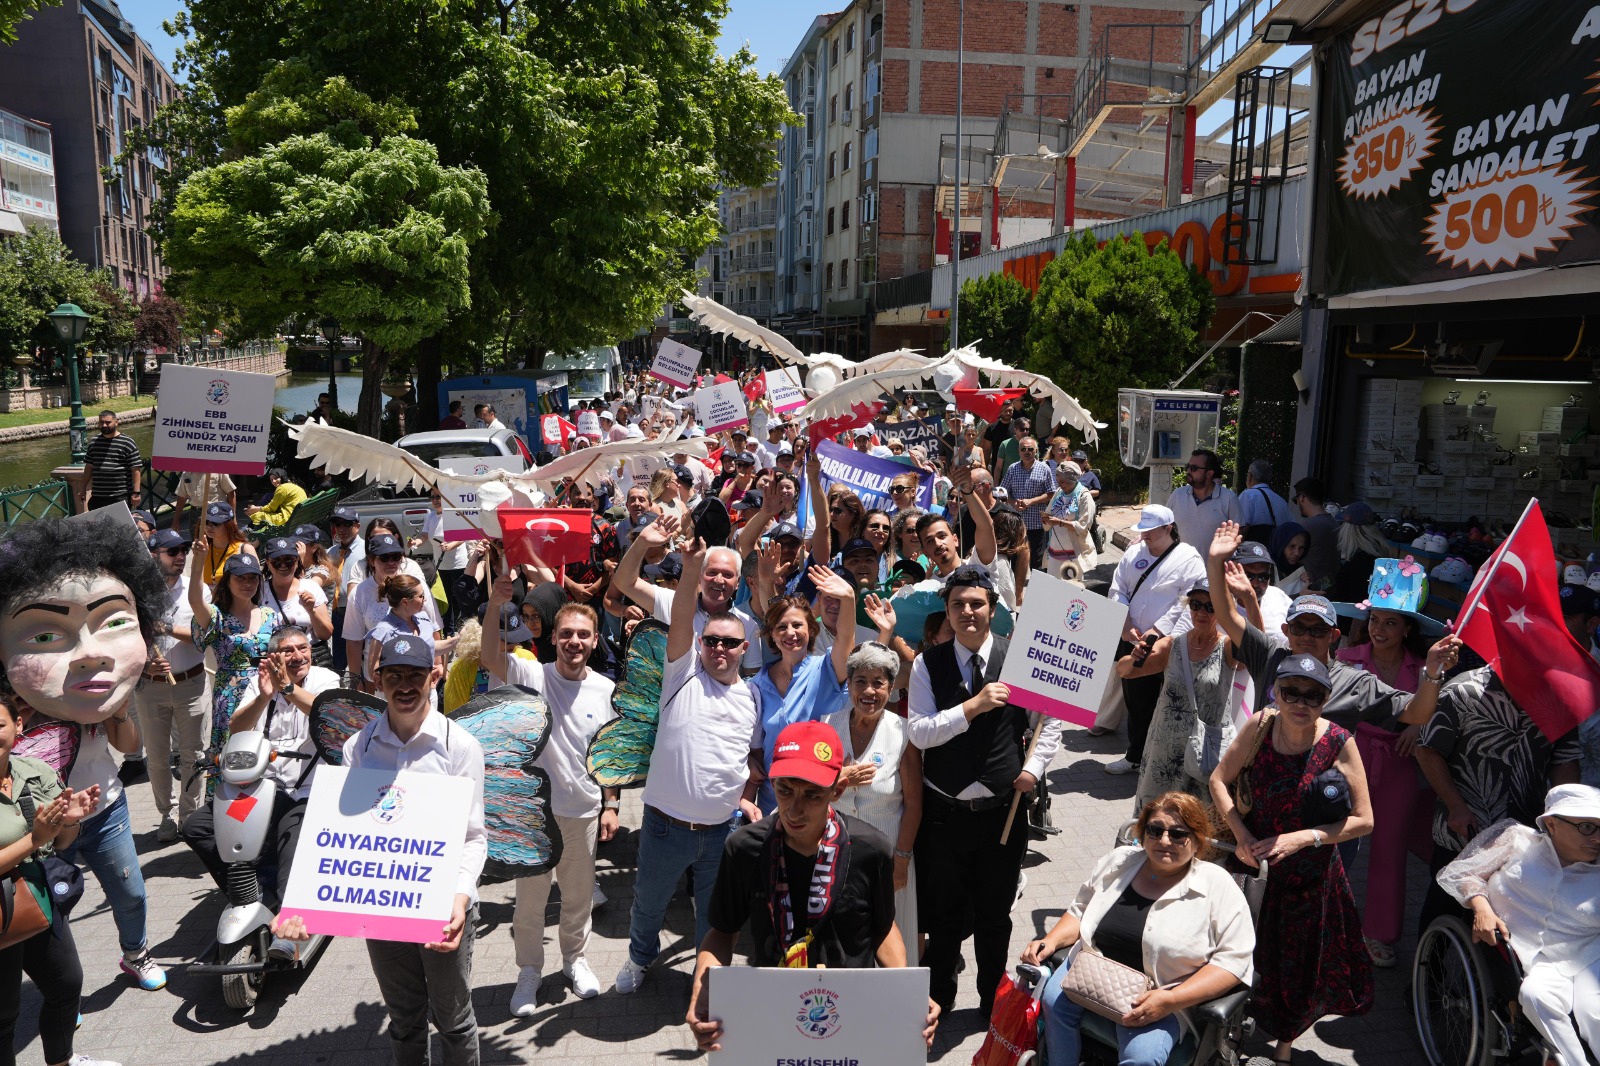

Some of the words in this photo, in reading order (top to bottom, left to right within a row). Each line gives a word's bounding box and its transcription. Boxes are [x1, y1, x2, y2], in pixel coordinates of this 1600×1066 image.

[1354, 49, 1426, 106] BAYAN
[1343, 73, 1442, 141] AYAKKABI
[1452, 93, 1570, 157] BAYAN
[1428, 124, 1600, 198] SANDALET
[204, 410, 227, 419] EBB
[1162, 402, 1210, 410] TELEFON
[162, 417, 215, 430] ZİHİNSEL
[218, 422, 264, 433] ENGELLİ
[168, 430, 217, 441] GÜNDÜZ
[220, 434, 257, 444] YAŞAM
[186, 442, 237, 454] MERKEZİ
[1033, 629, 1067, 650] PELİT
[1067, 642, 1098, 665] GENÇ
[1026, 646, 1094, 679] ENGELLİLER
[1030, 667, 1082, 693] DERNEĞİ
[316, 828, 447, 857] ÖNYARGINIZ
[318, 857, 433, 883] ENGELİNİZ
[317, 884, 423, 910] OLMASIN!
[799, 987, 840, 1000] ESKİŞEHİR
